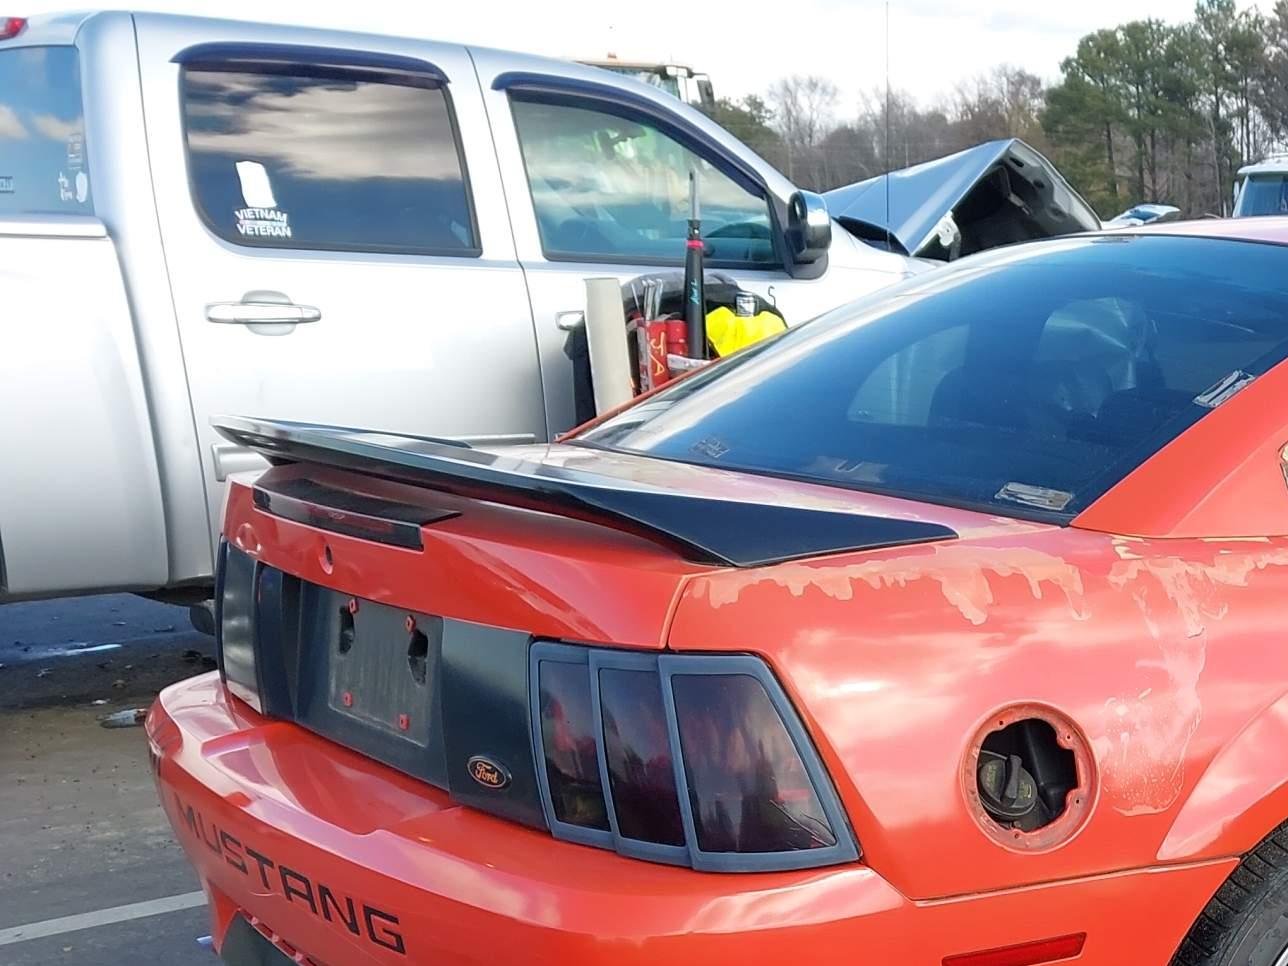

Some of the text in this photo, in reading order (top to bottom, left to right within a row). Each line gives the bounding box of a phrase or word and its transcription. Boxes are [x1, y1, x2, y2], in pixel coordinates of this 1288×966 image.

[234, 208, 288, 224] VIETNAM
[236, 223, 292, 238] VETERAN
[475, 761, 498, 784] Ford
[174, 791, 406, 955] MUSTANG
